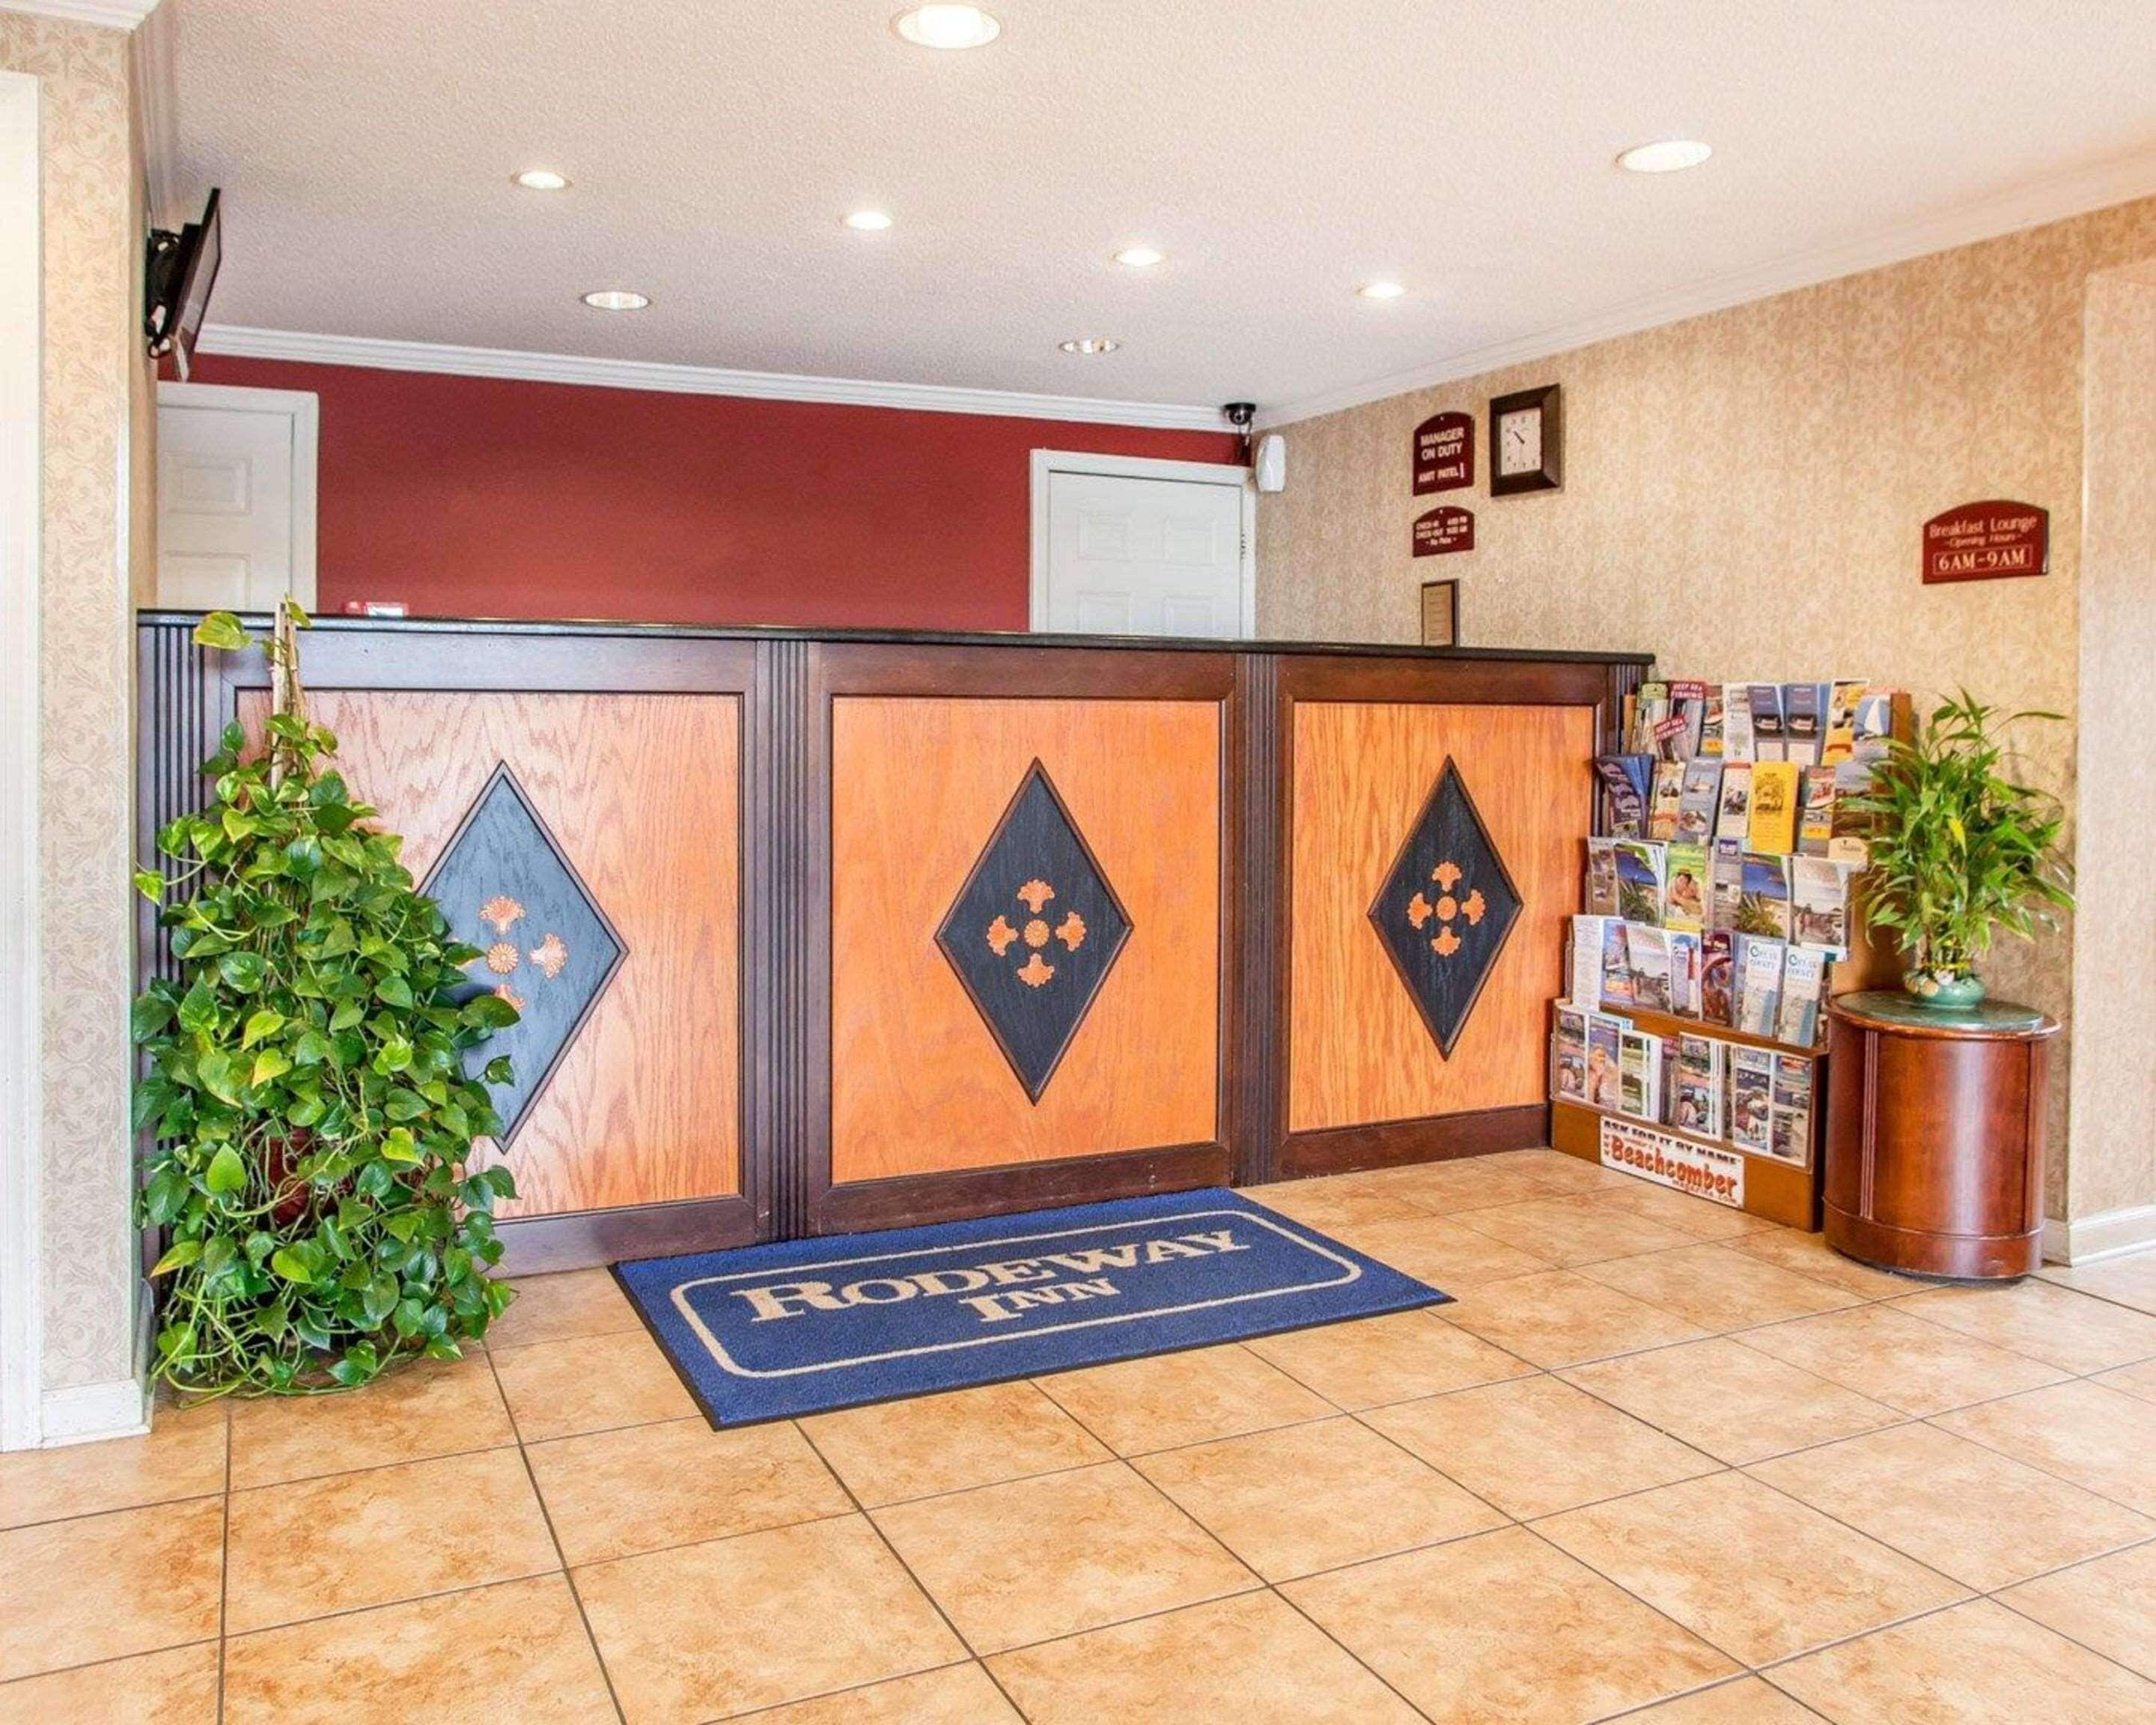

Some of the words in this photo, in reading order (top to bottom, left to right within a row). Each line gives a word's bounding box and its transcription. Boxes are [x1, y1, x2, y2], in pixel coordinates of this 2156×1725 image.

[1420, 426, 1464, 447] MANAGER
[1421, 447, 1436, 461] ON
[1438, 441, 1463, 458] DUTY
[1928, 519, 1985, 539] Breakfast
[1990, 516, 2038, 534] Lounge
[1938, 548, 2026, 571] 6AM-9AM
[1611, 1134, 1738, 1197] Beachcomber
[729, 1229, 1251, 1323] RODEWAY
[959, 1277, 1122, 1324] INN
